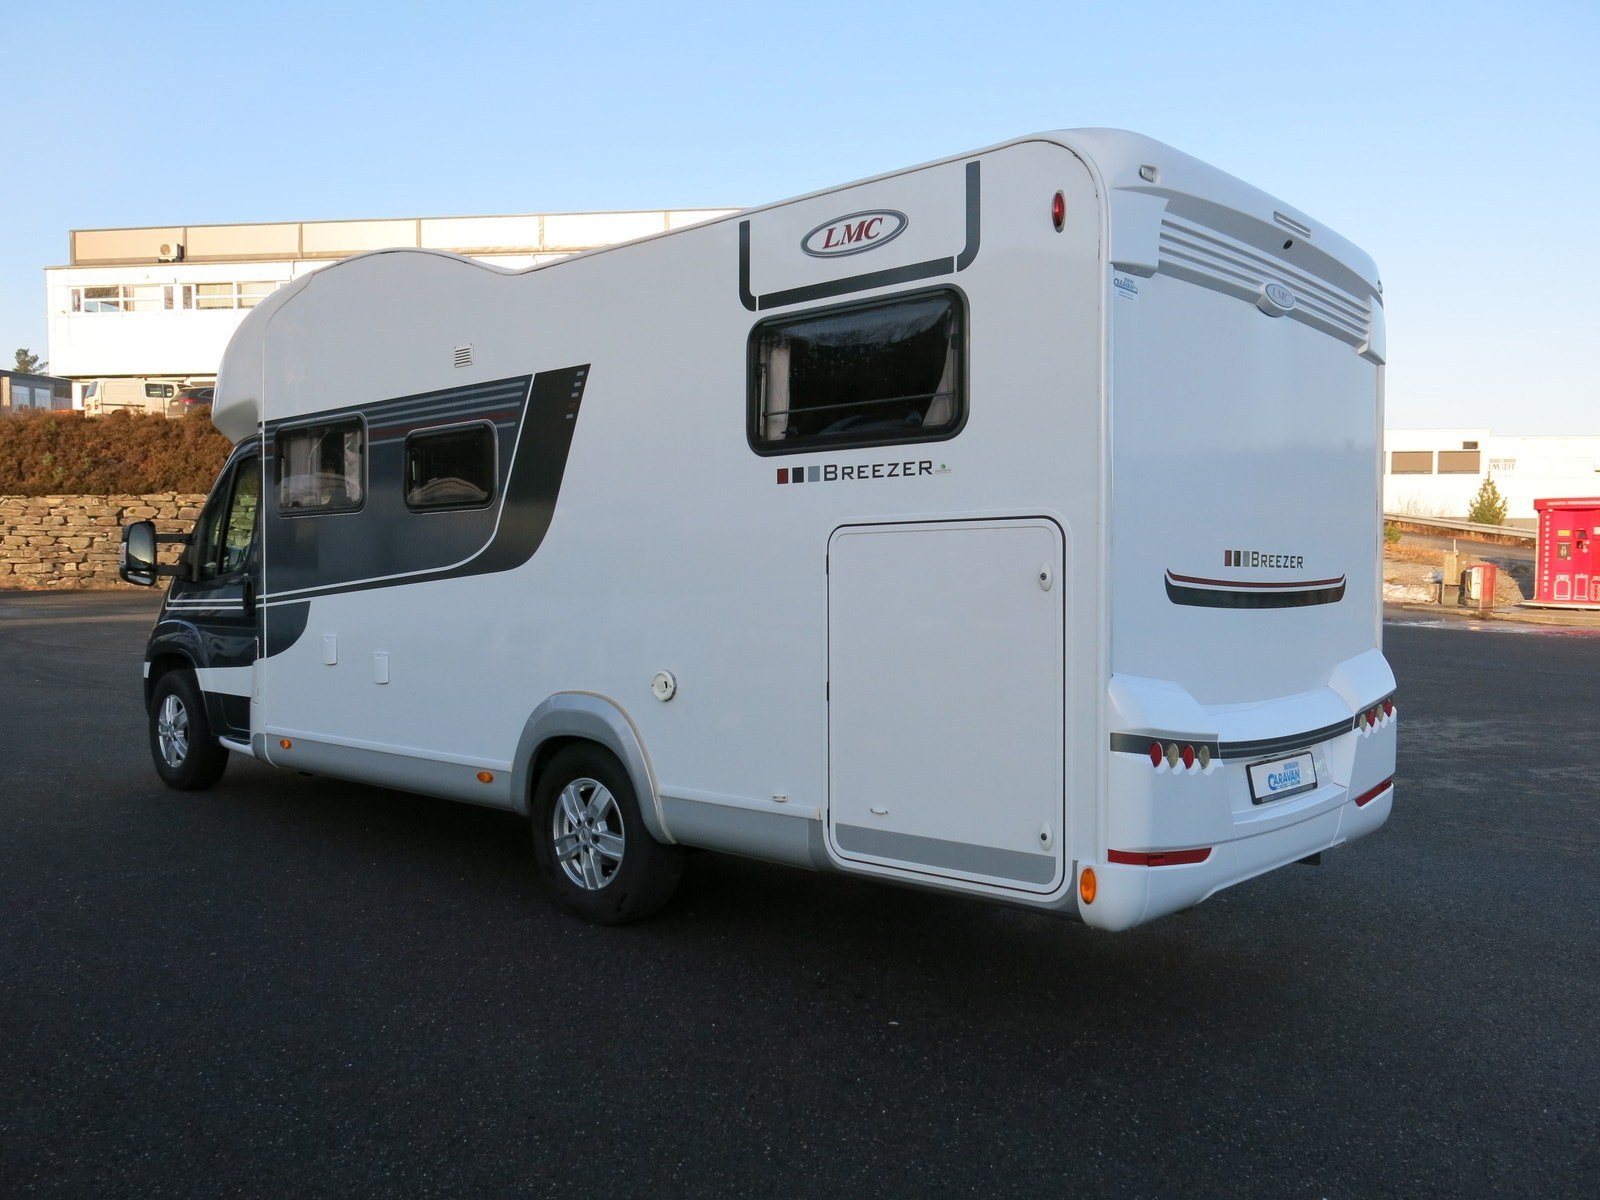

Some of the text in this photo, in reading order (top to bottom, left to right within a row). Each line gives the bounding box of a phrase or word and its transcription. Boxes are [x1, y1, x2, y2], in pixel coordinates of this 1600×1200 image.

[822, 217, 883, 249] LMC
[1272, 288, 1289, 302] LMC
[824, 460, 933, 481] BREEZER
[1251, 551, 1303, 568] BREEZER
[1268, 768, 1300, 790] CARAVAN
